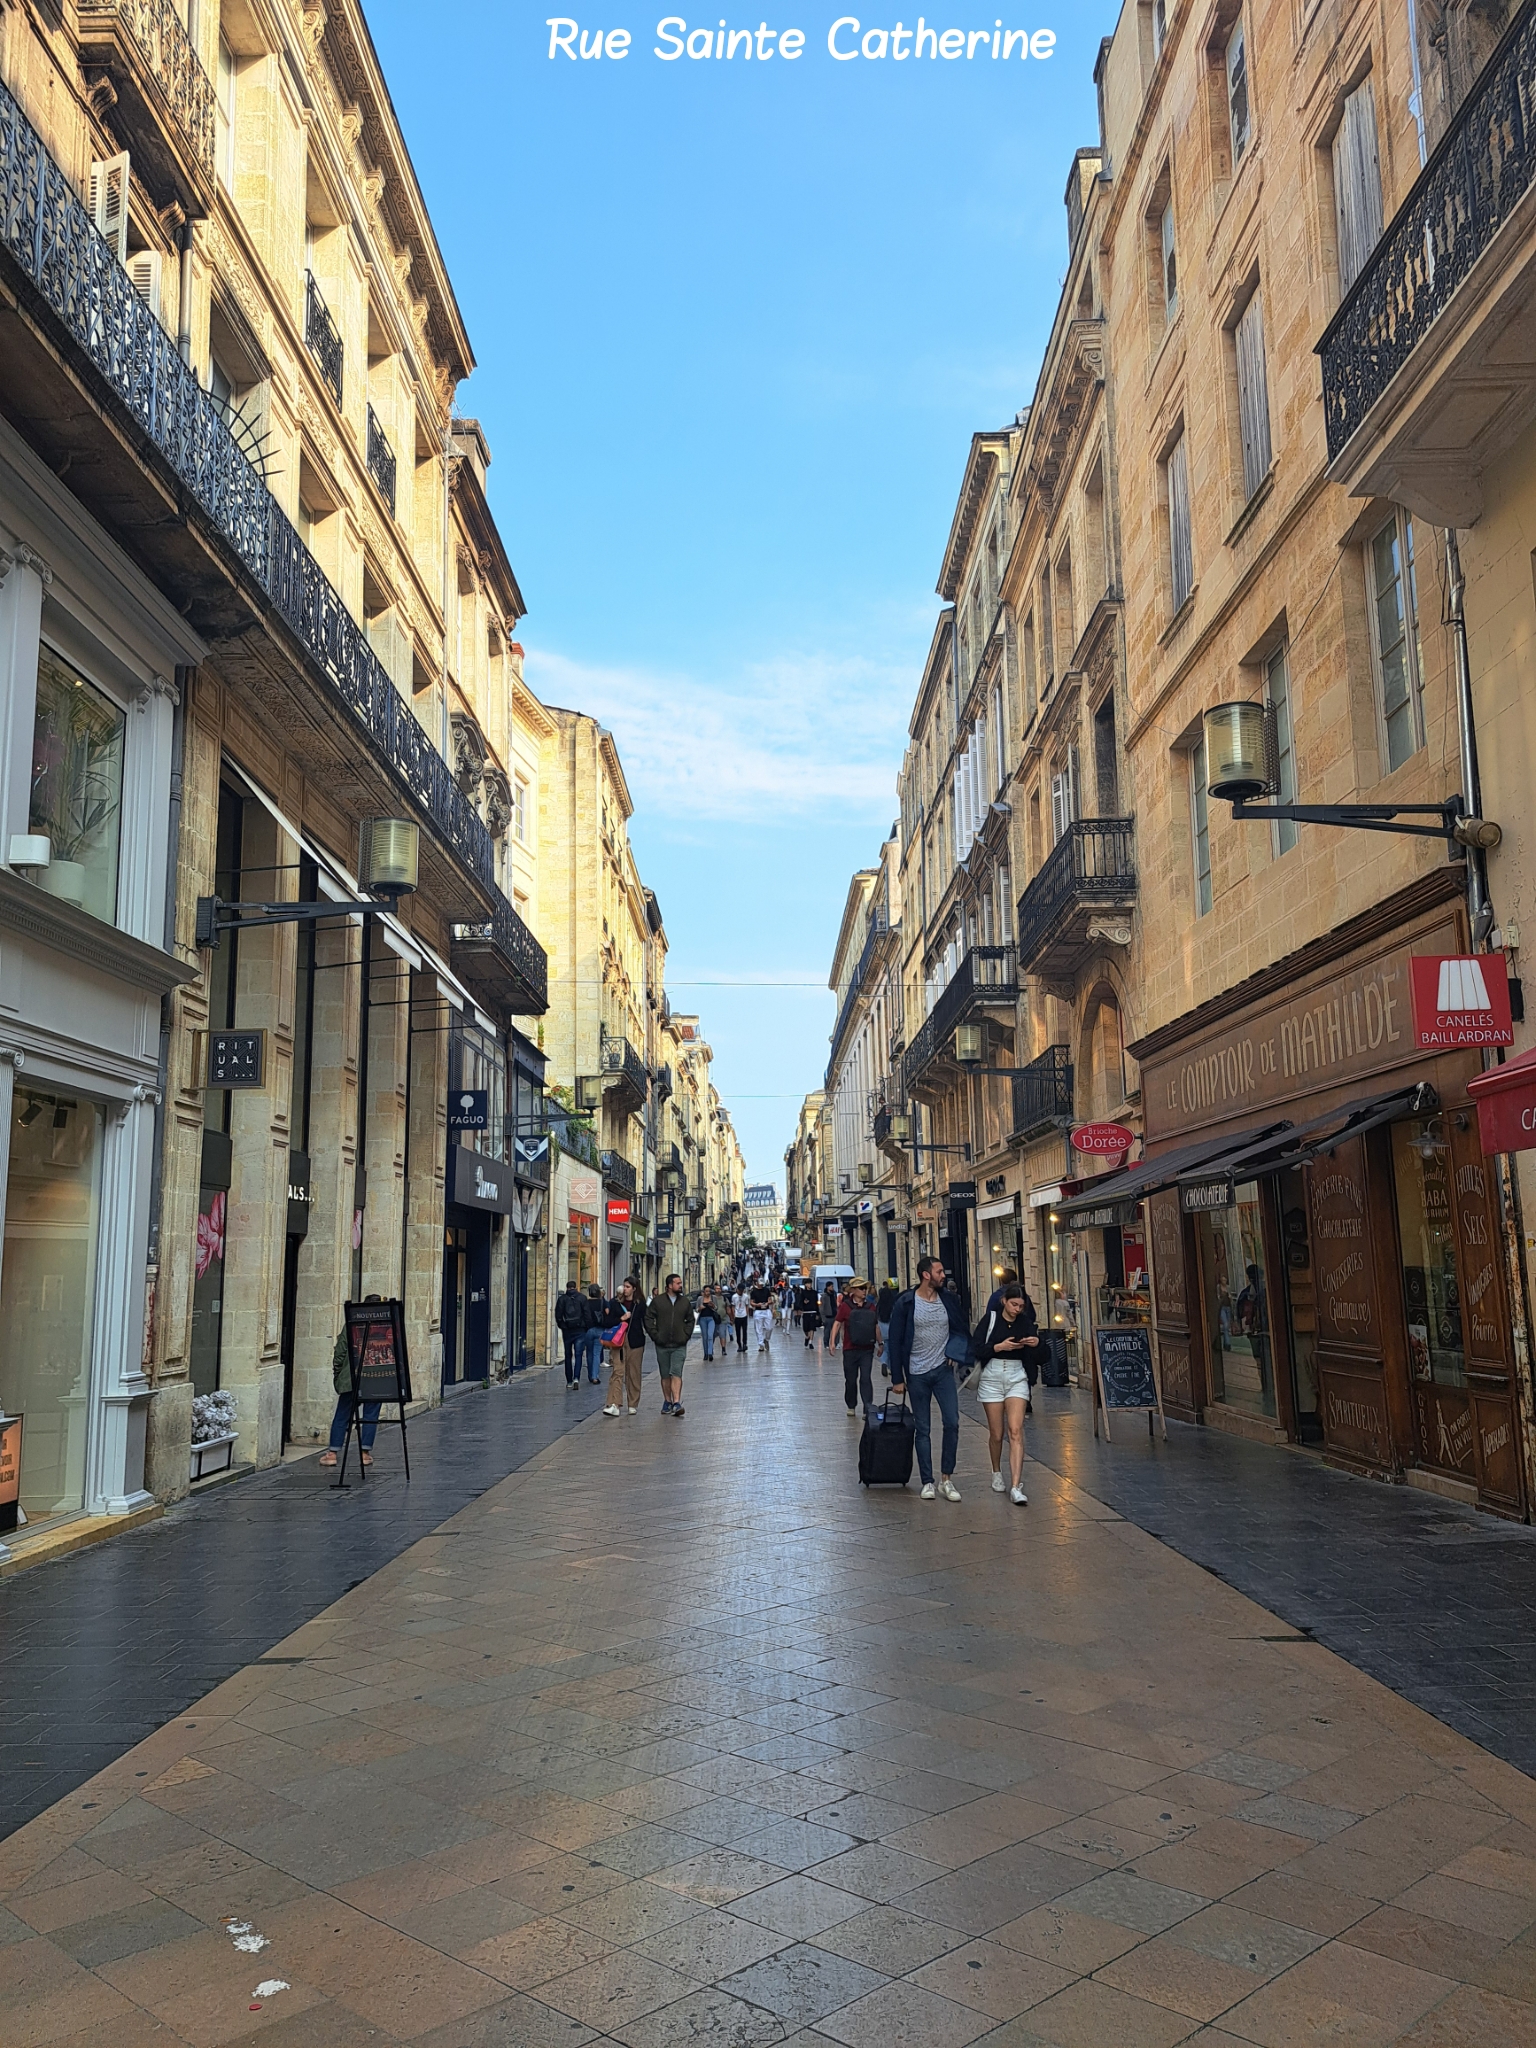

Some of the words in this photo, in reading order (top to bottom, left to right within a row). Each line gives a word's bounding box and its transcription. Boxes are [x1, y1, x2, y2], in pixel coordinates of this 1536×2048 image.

[1436, 1012, 1494, 1028] CANELÉS
[1166, 1080, 1178, 1110] LE
[1180, 1038, 1256, 1114] COMPTOIR
[1259, 1038, 1277, 1076] DE
[1279, 973, 1400, 1078] MATHILDE
[1421, 1029, 1512, 1044] BAILLARDRAN
[450, 1115, 484, 1125] FAGUO
[1087, 1127, 1118, 1135] Brioche
[1081, 1135, 1127, 1149] Dorée
[1421, 1188, 1448, 1207] BABA
